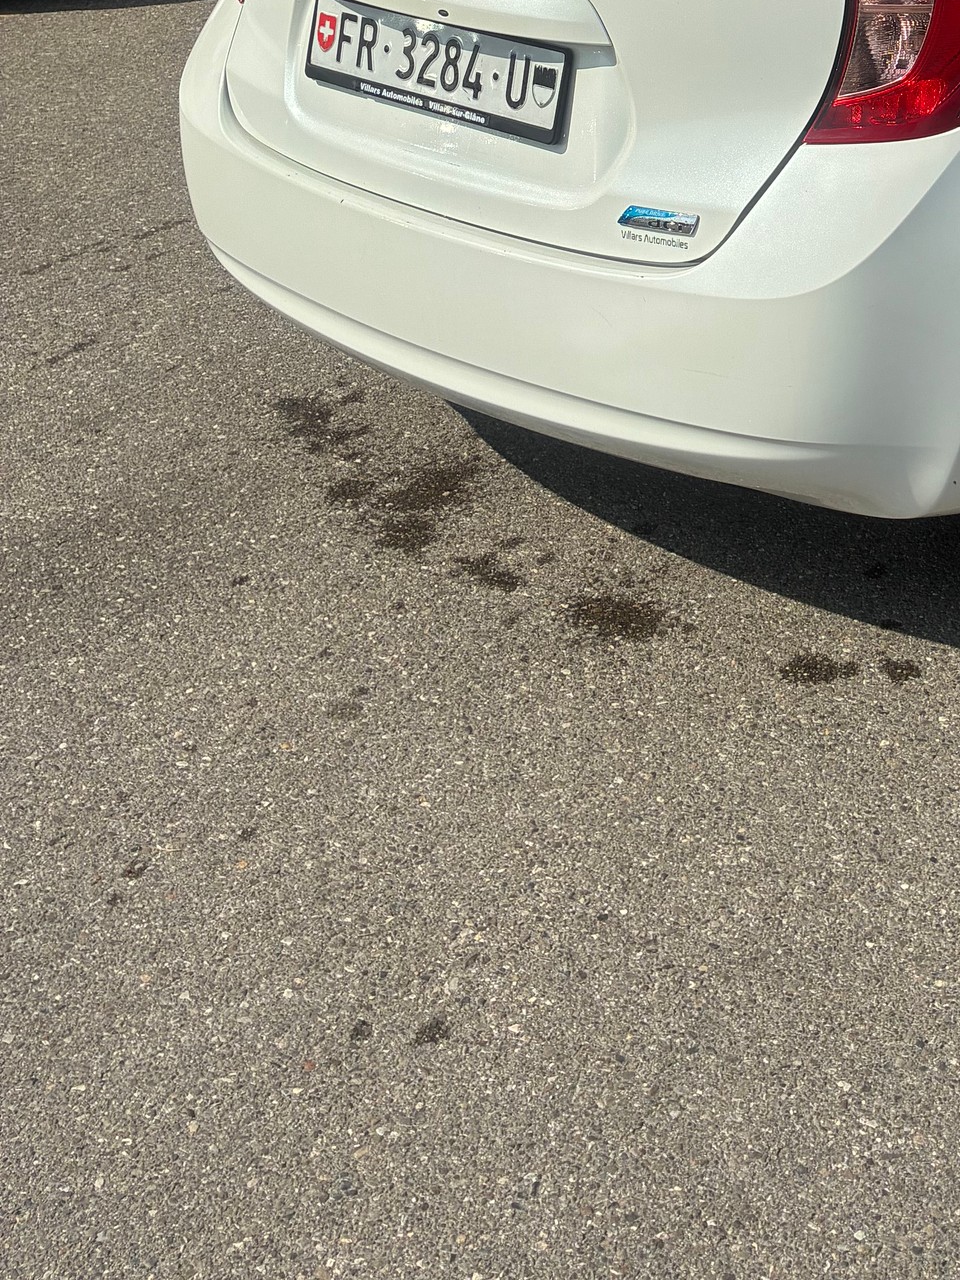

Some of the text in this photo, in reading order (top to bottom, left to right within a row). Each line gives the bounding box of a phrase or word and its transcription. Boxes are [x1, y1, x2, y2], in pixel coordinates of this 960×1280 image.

[360, 82, 381, 95] Villars
[381, 88, 424, 107] Automobiles
[621, 230, 689, 249] Villars Automobiles
